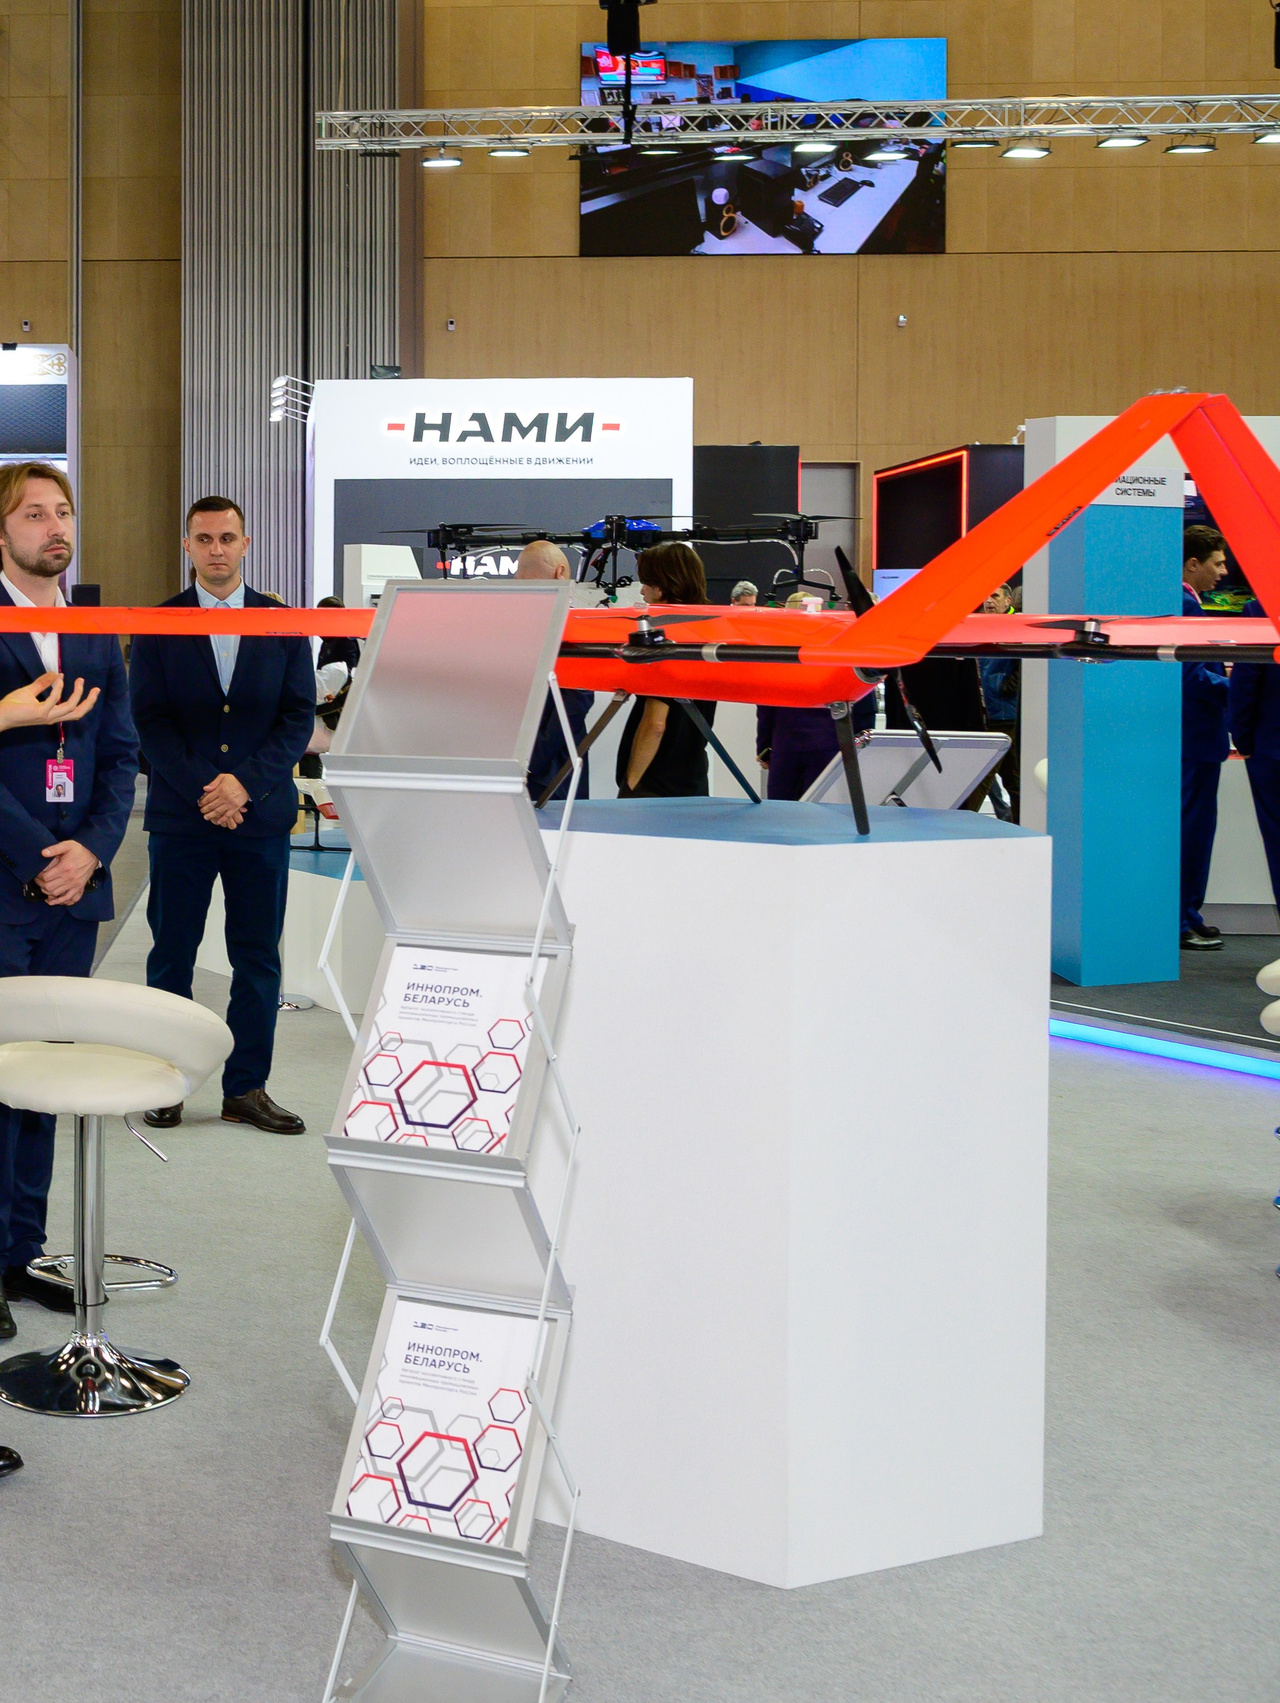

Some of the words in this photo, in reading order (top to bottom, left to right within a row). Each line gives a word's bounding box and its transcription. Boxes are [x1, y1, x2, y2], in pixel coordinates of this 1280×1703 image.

[412, 412, 595, 442] НАМИ
[409, 457, 439, 466] ИДЕИ,
[441, 455, 524, 466] ВОПЛОЩЁННЫЕ
[526, 457, 533, 465] В
[534, 457, 594, 466] ДВИЖЕНИИ
[1114, 487, 1156, 497] СИСТЕМЫ
[450, 555, 519, 576] НАМ
[406, 981, 483, 998] ИННОПРОМ.
[403, 993, 470, 1008] БЕЛАРУСЬ
[407, 1341, 483, 1363] ИННОПРОМ.
[404, 1354, 471, 1374] БЕЛАРУСЬ
